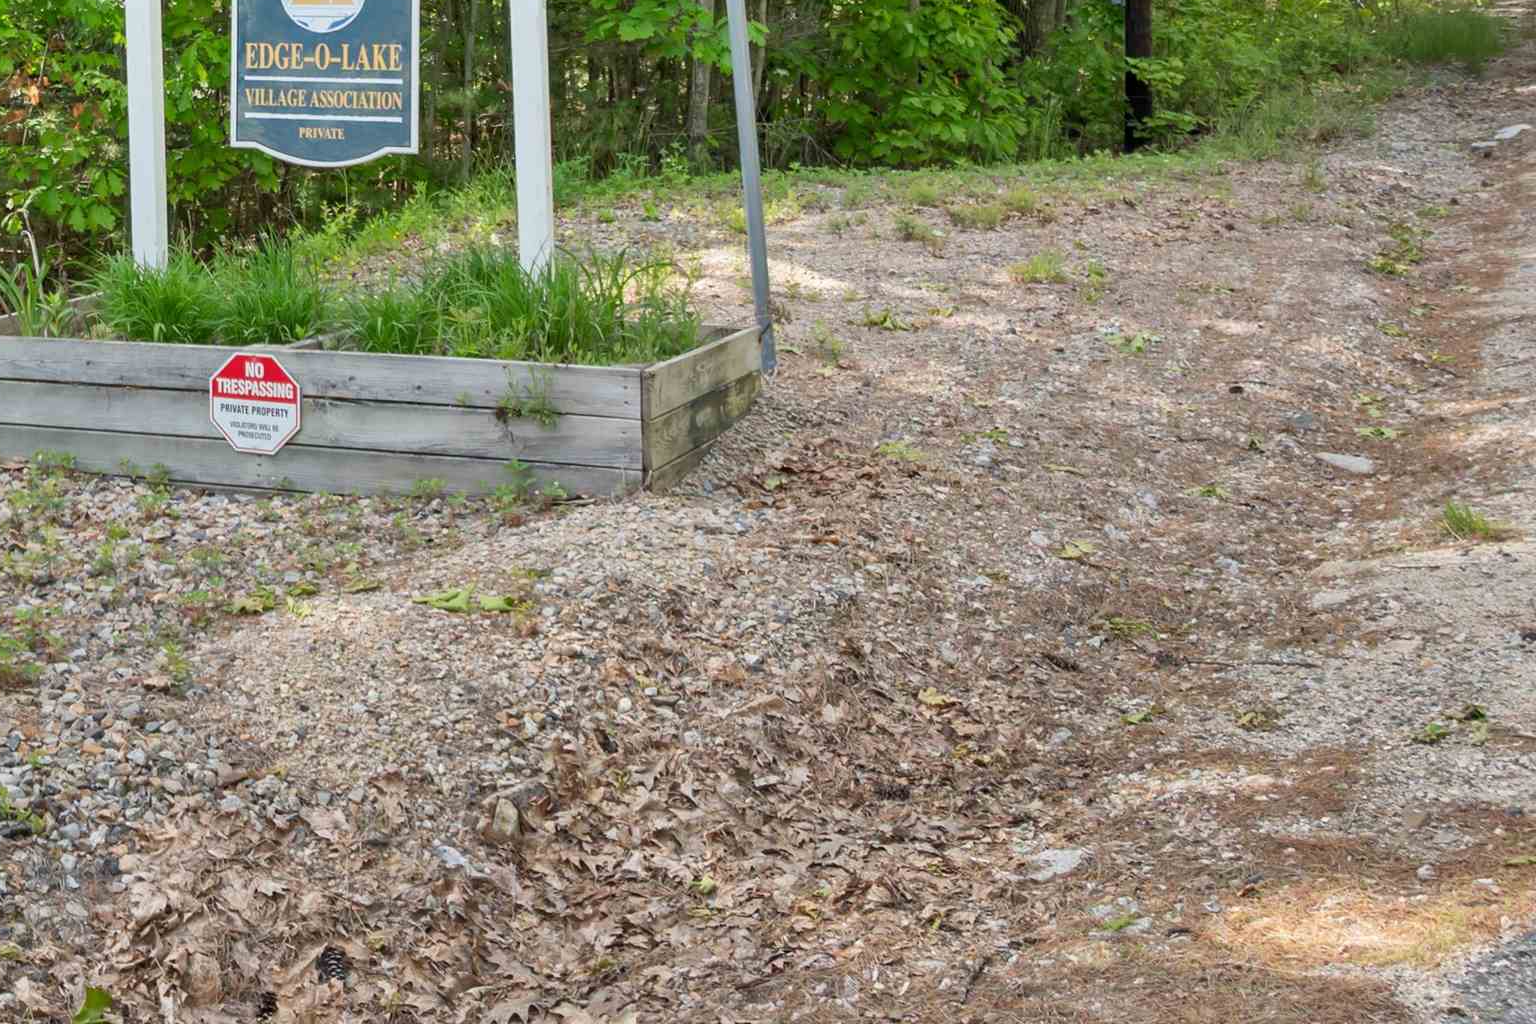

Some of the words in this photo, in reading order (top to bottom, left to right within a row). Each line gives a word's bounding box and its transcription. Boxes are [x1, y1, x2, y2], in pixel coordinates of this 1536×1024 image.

[245, 42, 403, 71] EDGE-O-LAKE
[245, 88, 306, 108] VILLAGE
[309, 90, 403, 110] ASSOCIATION
[298, 127, 345, 140] PRIVATE
[244, 361, 265, 378] NO
[216, 378, 294, 400] TRESPASSING
[220, 403, 249, 415] PRIVATE
[251, 406, 289, 418] PROPERTY
